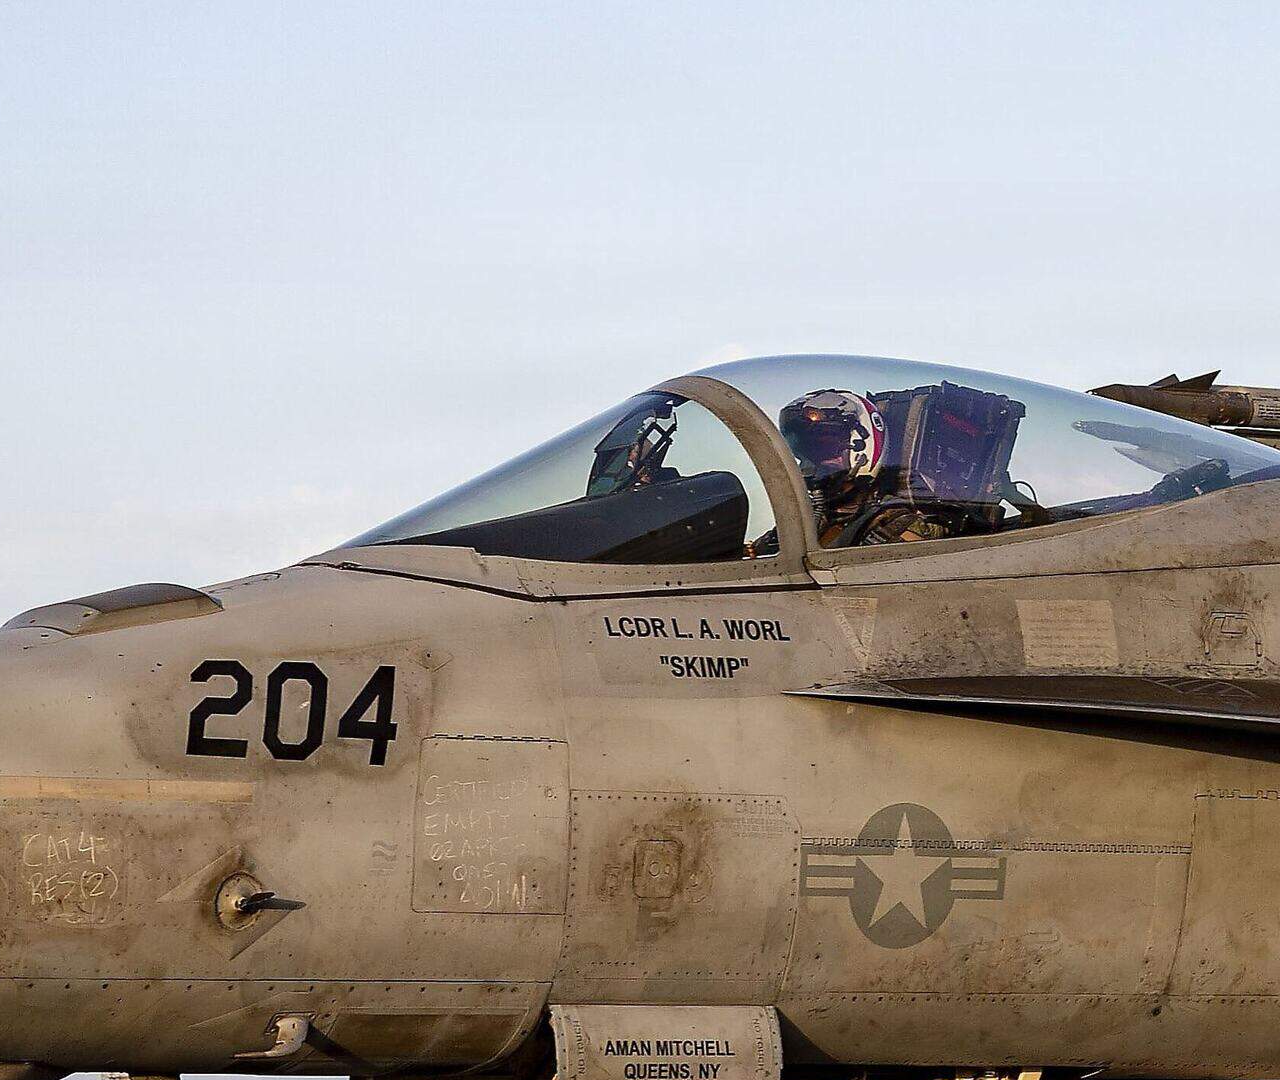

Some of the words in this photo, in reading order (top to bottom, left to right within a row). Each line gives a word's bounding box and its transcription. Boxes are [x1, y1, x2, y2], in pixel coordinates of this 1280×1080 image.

[604, 616, 669, 638] LCDR
[670, 617, 694, 639] L.
[699, 618, 721, 640] A.
[722, 619, 791, 642] WORL
[659, 655, 749, 679] "SKIMP"
[185, 660, 399, 767] 204
[604, 1040, 652, 1057] AMAN
[655, 1040, 736, 1057] MITCHELL
[698, 1063, 723, 1080] NY
